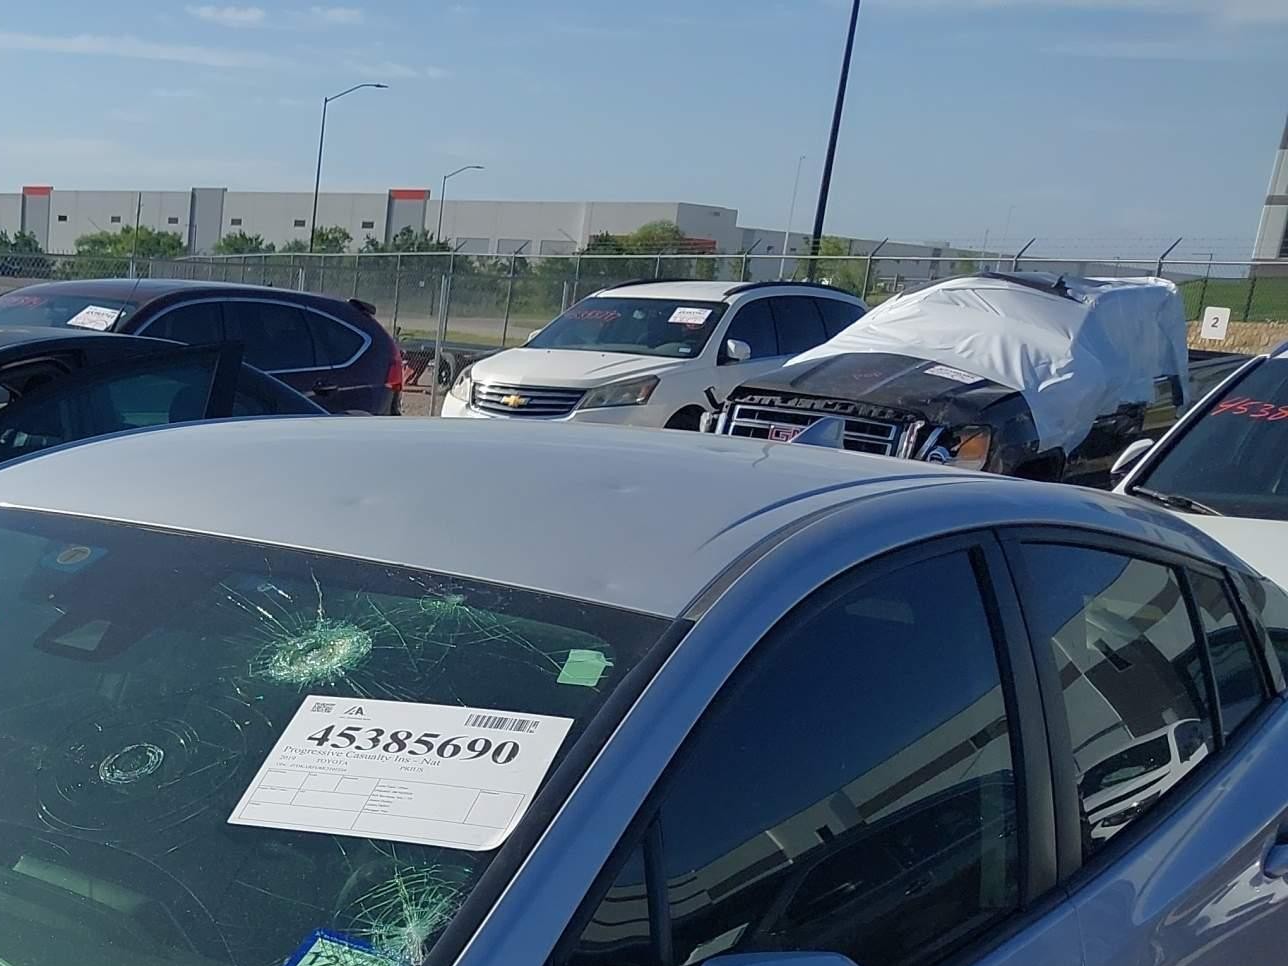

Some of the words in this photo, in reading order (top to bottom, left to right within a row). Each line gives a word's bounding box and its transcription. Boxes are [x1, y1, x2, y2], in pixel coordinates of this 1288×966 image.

[1210, 316, 1220, 328] 2
[306, 724, 520, 765] 45385690
[283, 745, 344, 758] Progressive
[346, 751, 392, 763] Casualty
[394, 755, 410, 763] Ins
[421, 757, 441, 766] Nat
[316, 758, 349, 766] TOYOTA
